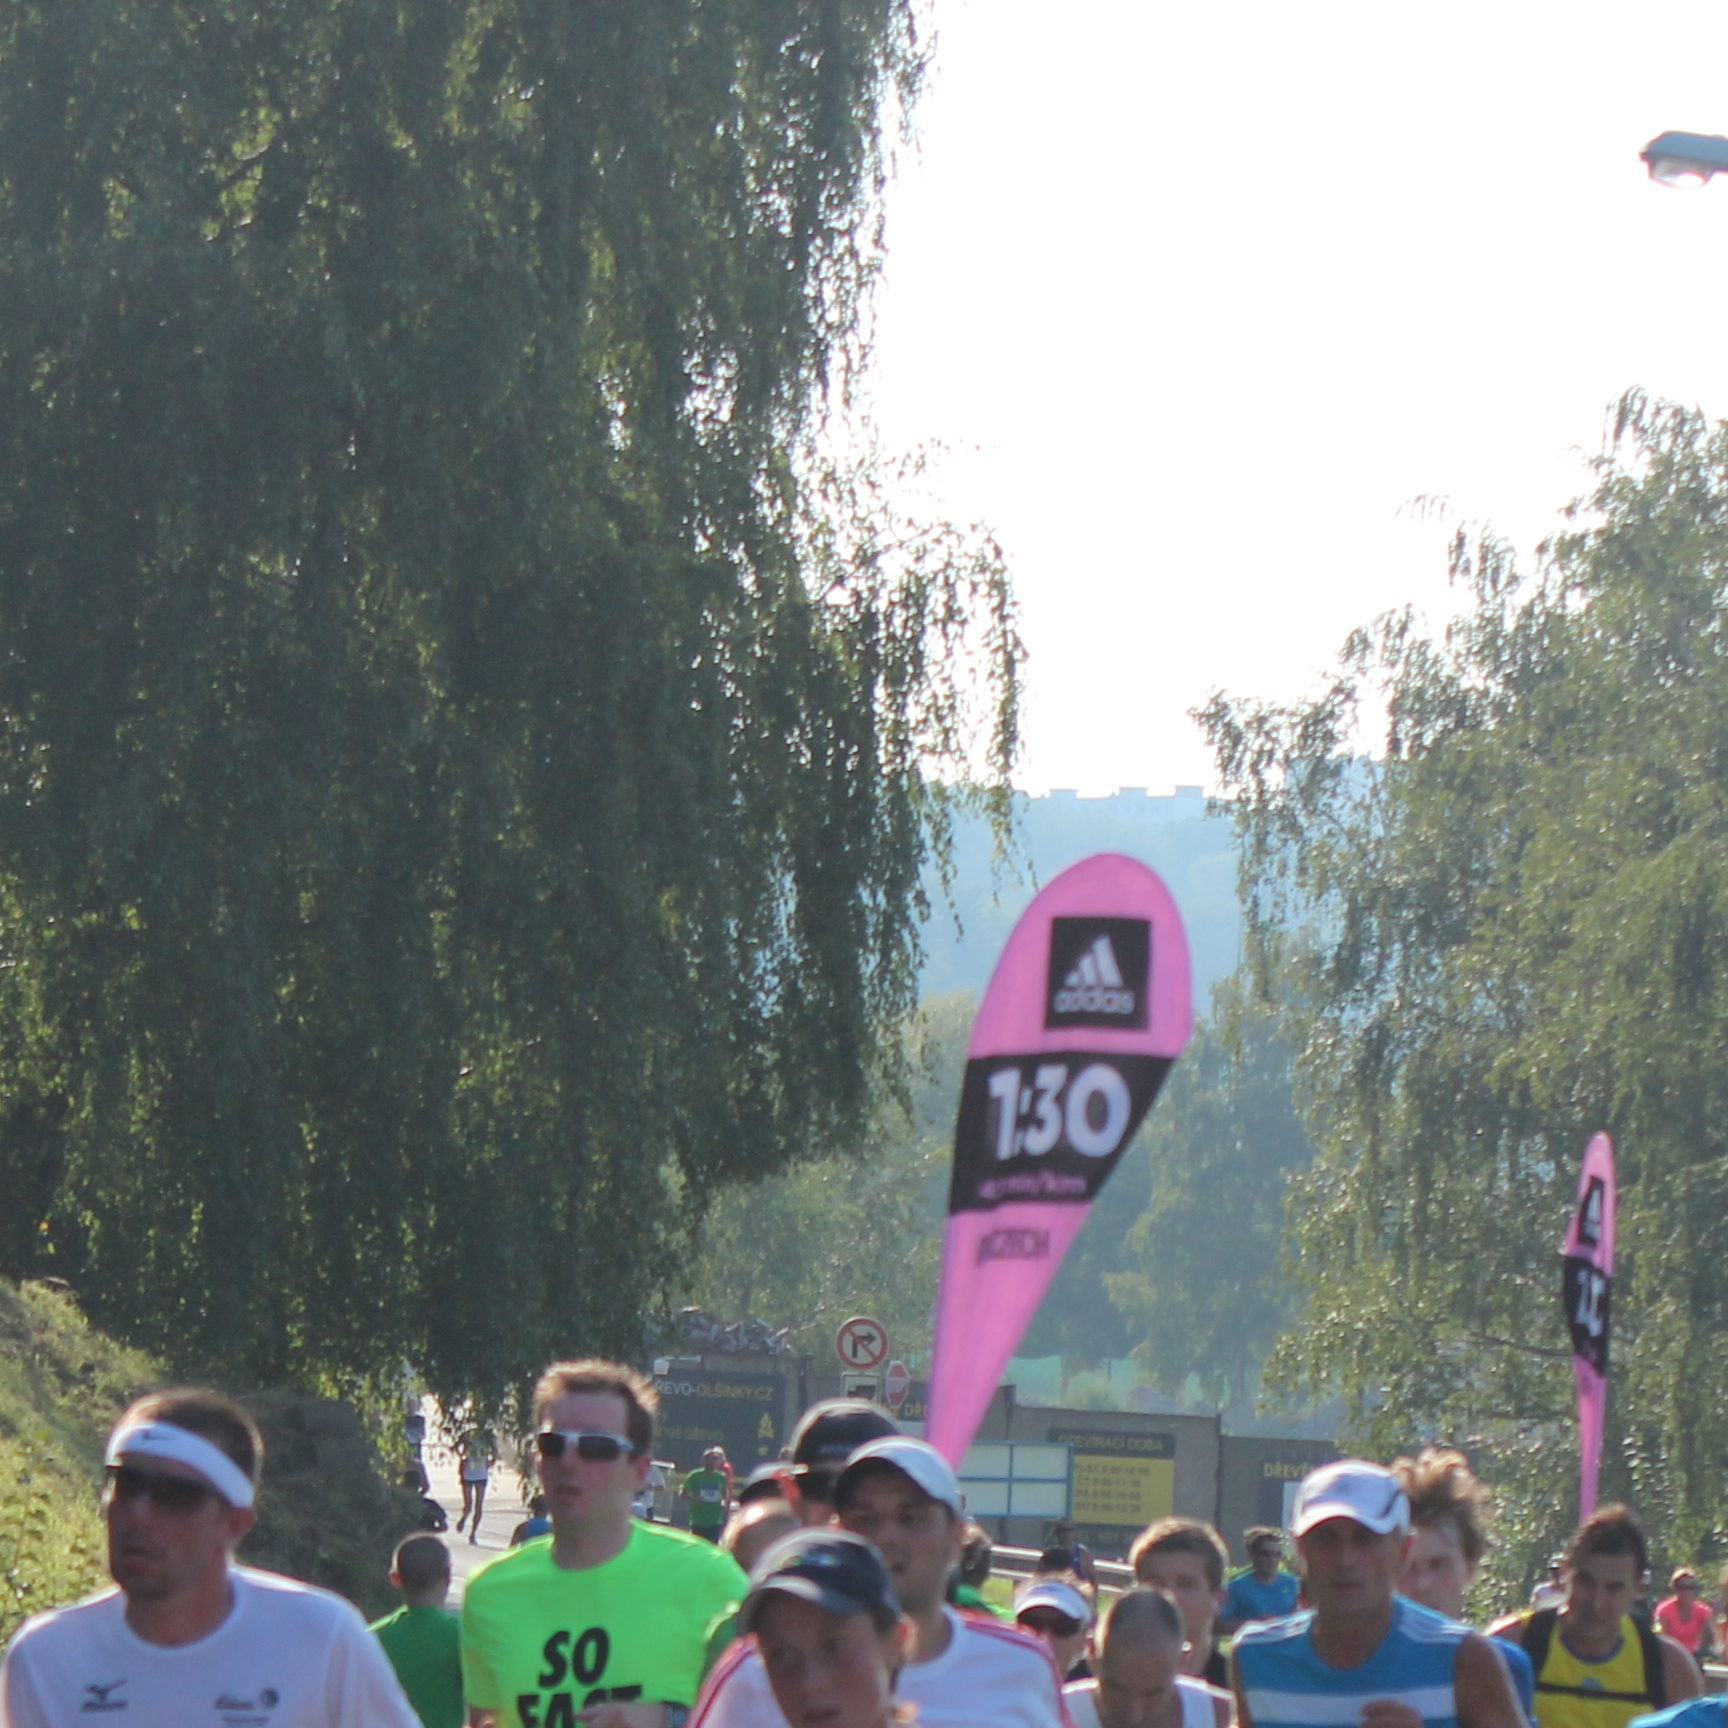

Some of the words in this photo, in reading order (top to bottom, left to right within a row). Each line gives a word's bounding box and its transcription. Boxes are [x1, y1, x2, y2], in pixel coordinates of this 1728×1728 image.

[1053, 985, 1135, 1015] adidas
[987, 1062, 1132, 1161] 1:30
[539, 1627, 610, 1688] SO
